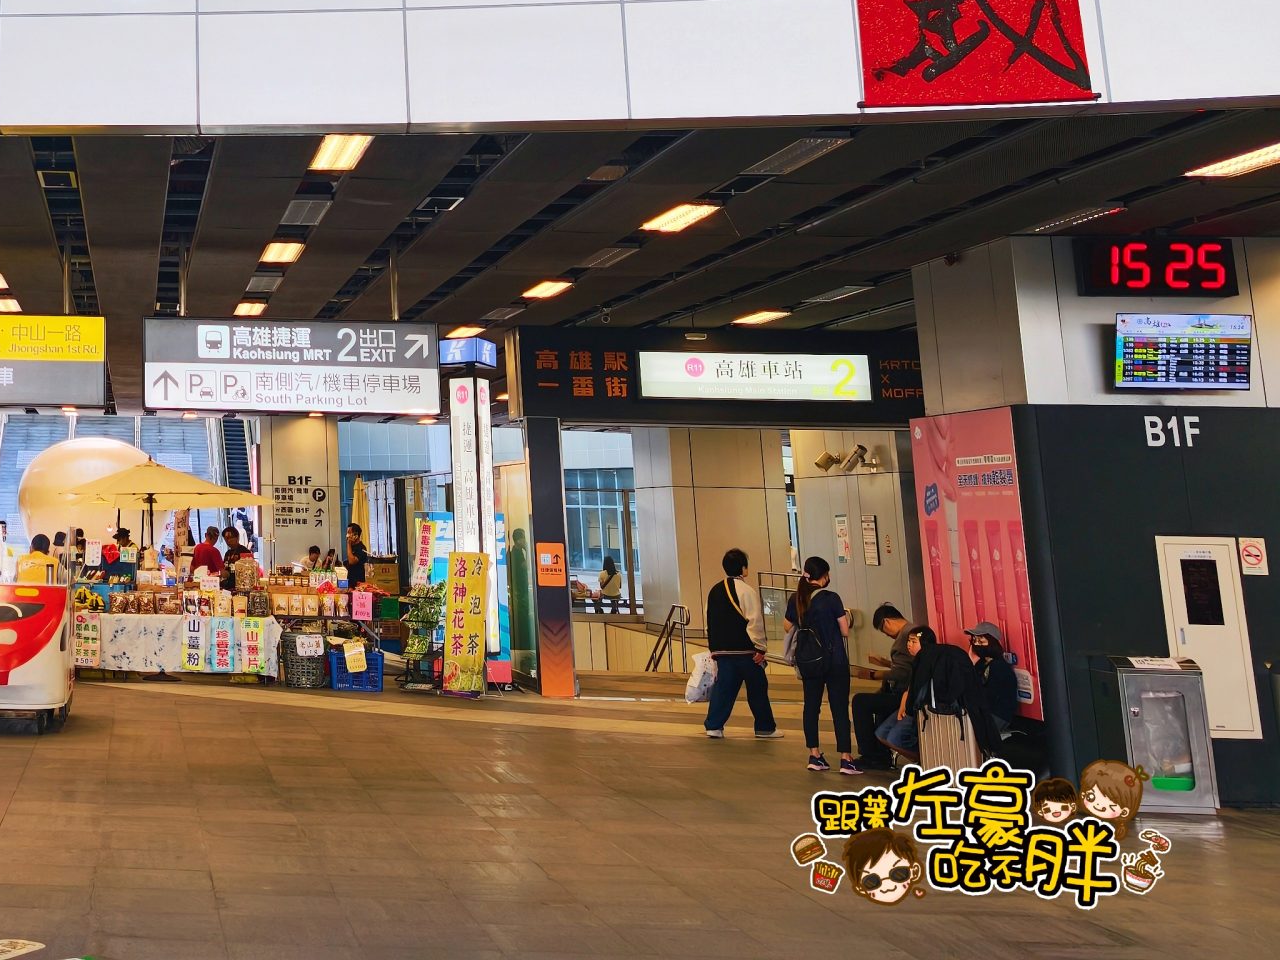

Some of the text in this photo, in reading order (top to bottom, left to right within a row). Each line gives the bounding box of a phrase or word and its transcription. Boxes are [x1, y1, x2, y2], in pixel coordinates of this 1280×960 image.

[11, 323, 81, 342] 中山一路
[233, 326, 311, 348] 高雄捷運
[360, 329, 396, 348] 出口
[337, 328, 358, 361] 2
[233, 348, 332, 363] Kaohsiung MRT
[360, 349, 396, 362] EXIT
[715, 360, 803, 379] 高雄車站
[831, 358, 858, 396] 2
[255, 393, 367, 407] South Parking Lot
[1144, 416, 1200, 447] B1F
[288, 476, 312, 485] B1F
[451, 557, 468, 656] 洛神花茶
[467, 557, 483, 656] 冷泡茶
